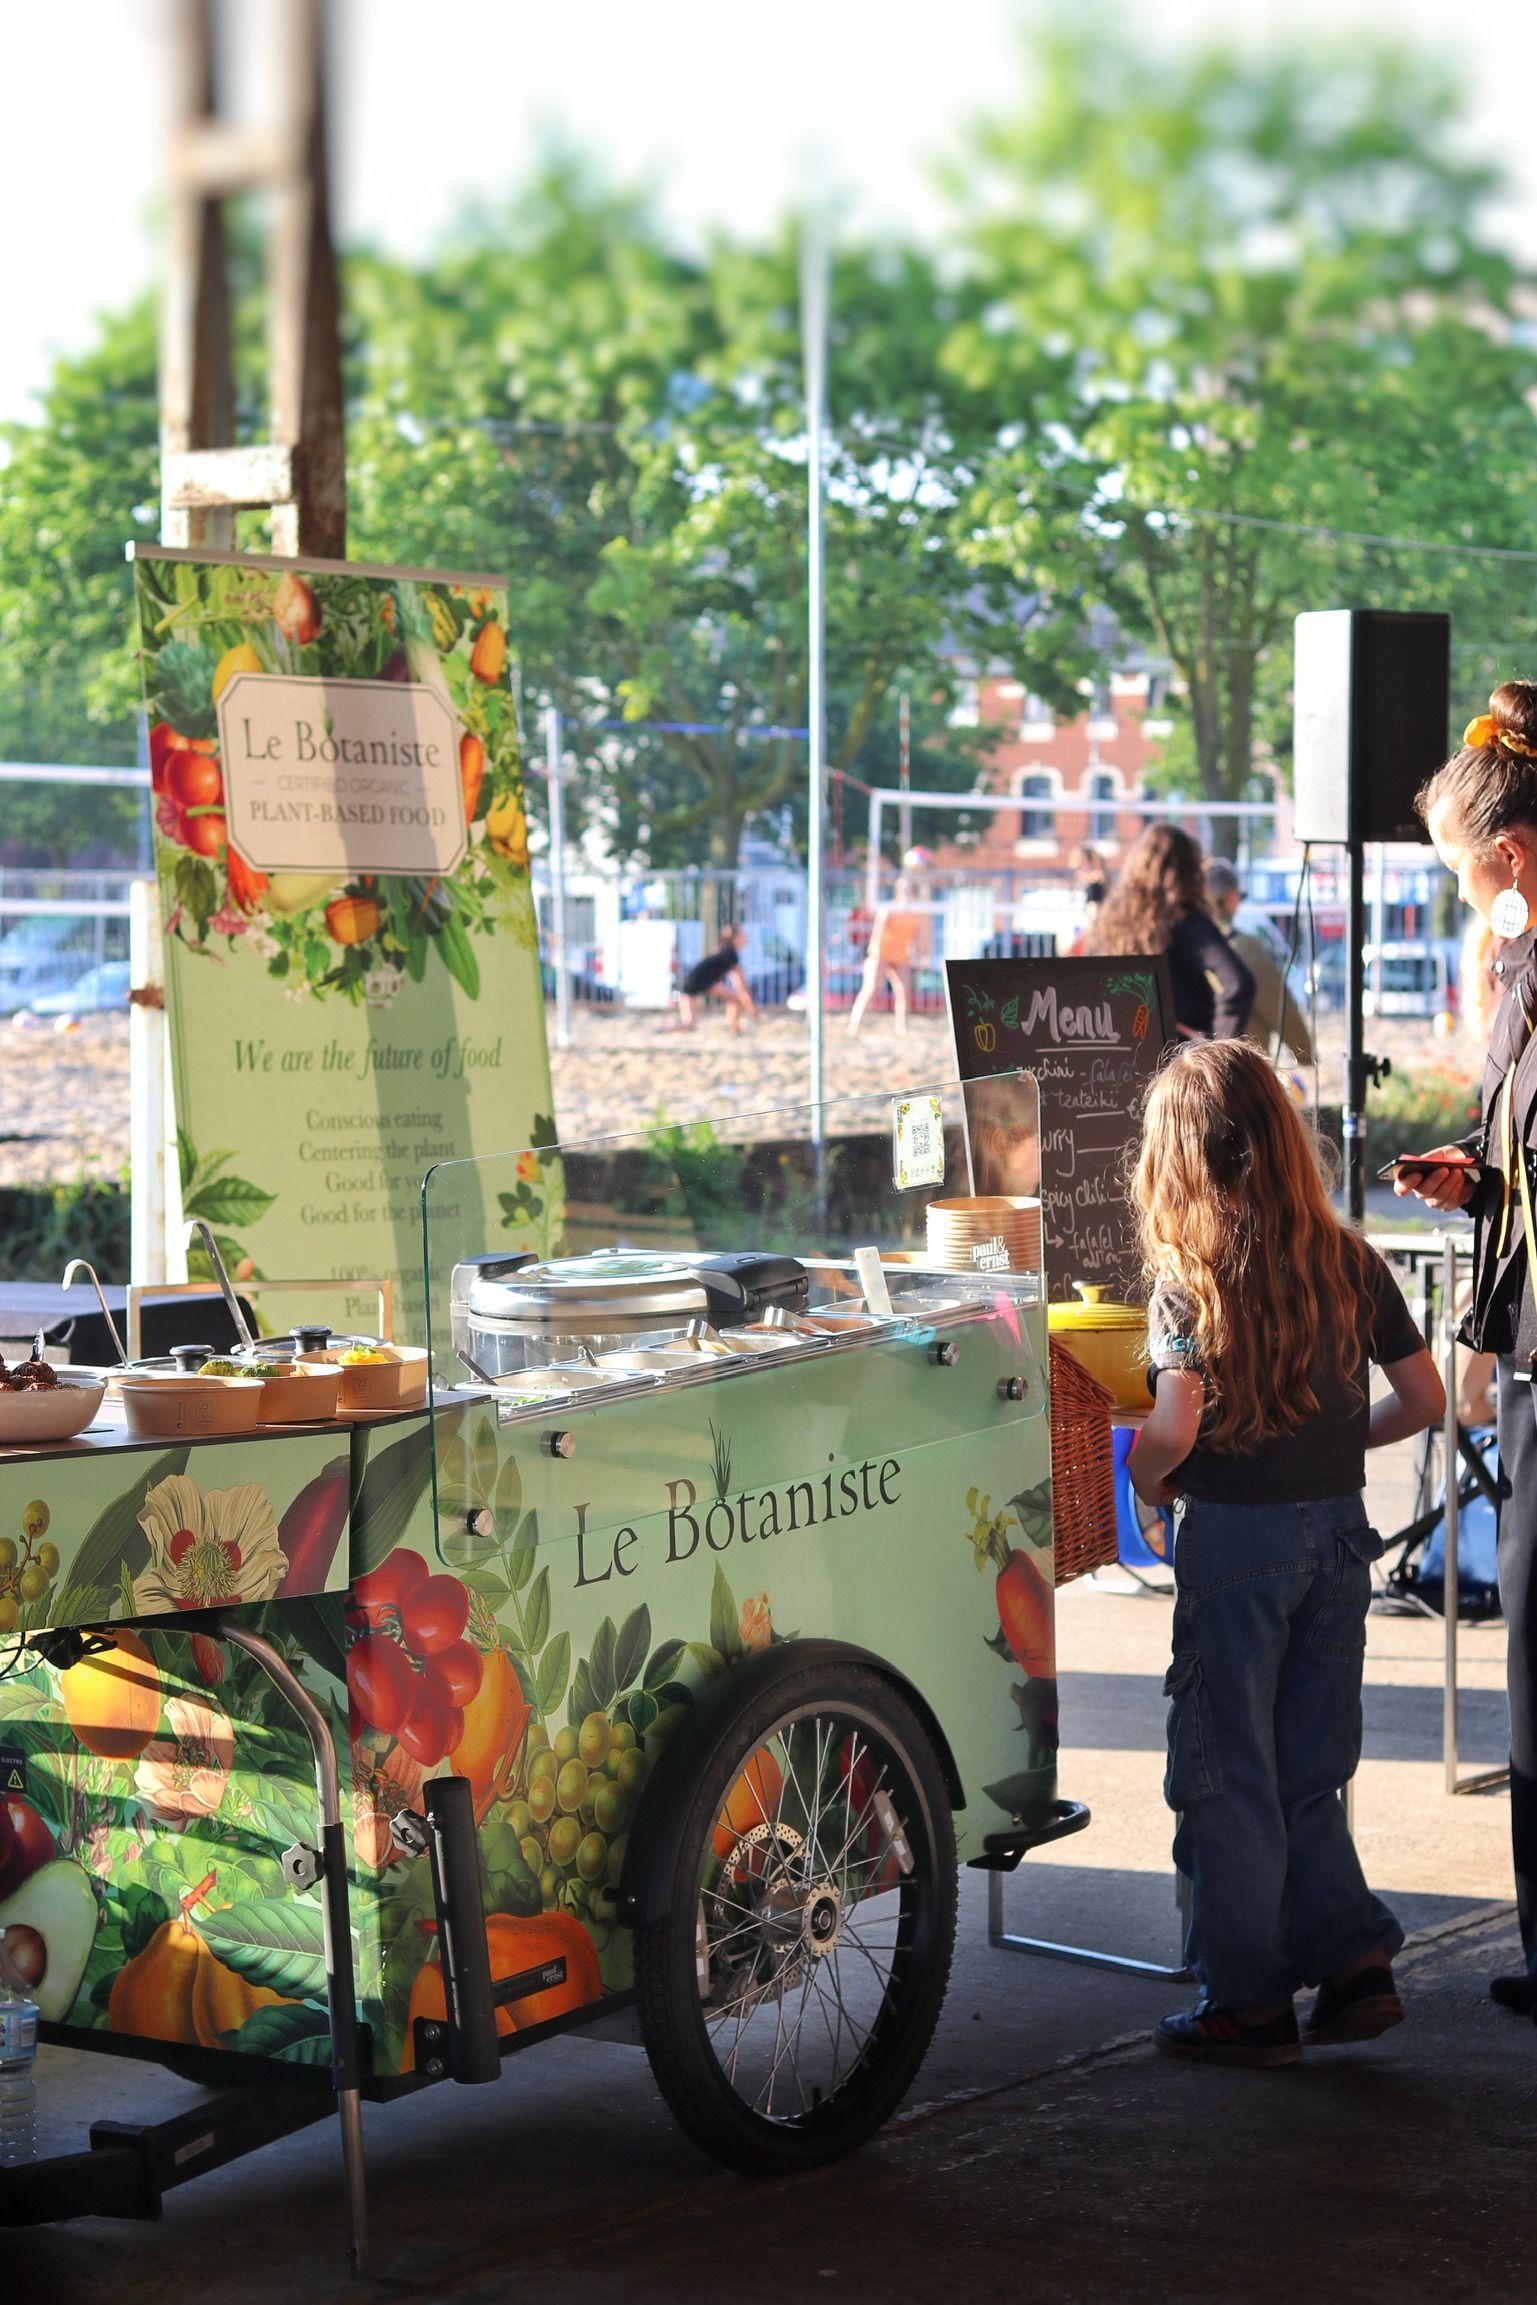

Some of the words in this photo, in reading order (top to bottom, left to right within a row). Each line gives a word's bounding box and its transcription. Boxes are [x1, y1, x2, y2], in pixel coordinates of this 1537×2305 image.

[242, 717, 282, 760] Le
[295, 719, 440, 768] Botaniste
[250, 800, 385, 825] PLANT-BASED
[389, 804, 446, 826] FOOD
[1021, 986, 1121, 1043] Menu
[235, 1039, 273, 1072] We
[281, 1050, 314, 1072] are
[322, 1039, 355, 1072] the
[356, 1038, 423, 1080] future
[431, 1037, 458, 1080] of
[452, 1037, 502, 1079] food
[306, 1108, 391, 1131] Conscious
[394, 1107, 442, 1133] eating
[299, 1139, 383, 1166] Centering
[386, 1138, 409, 1159] the
[414, 1137, 455, 1164] plant
[1040, 1128, 1075, 1177] urry
[325, 1170, 375, 1193] Good
[379, 1167, 400, 1190] for
[300, 1203, 349, 1226] Good
[352, 1201, 377, 1223] for
[381, 1200, 405, 1222] the
[979, 1249, 1010, 1270] ernst
[573, 1502, 640, 1588] Le
[664, 1451, 902, 1564] Botaniste
